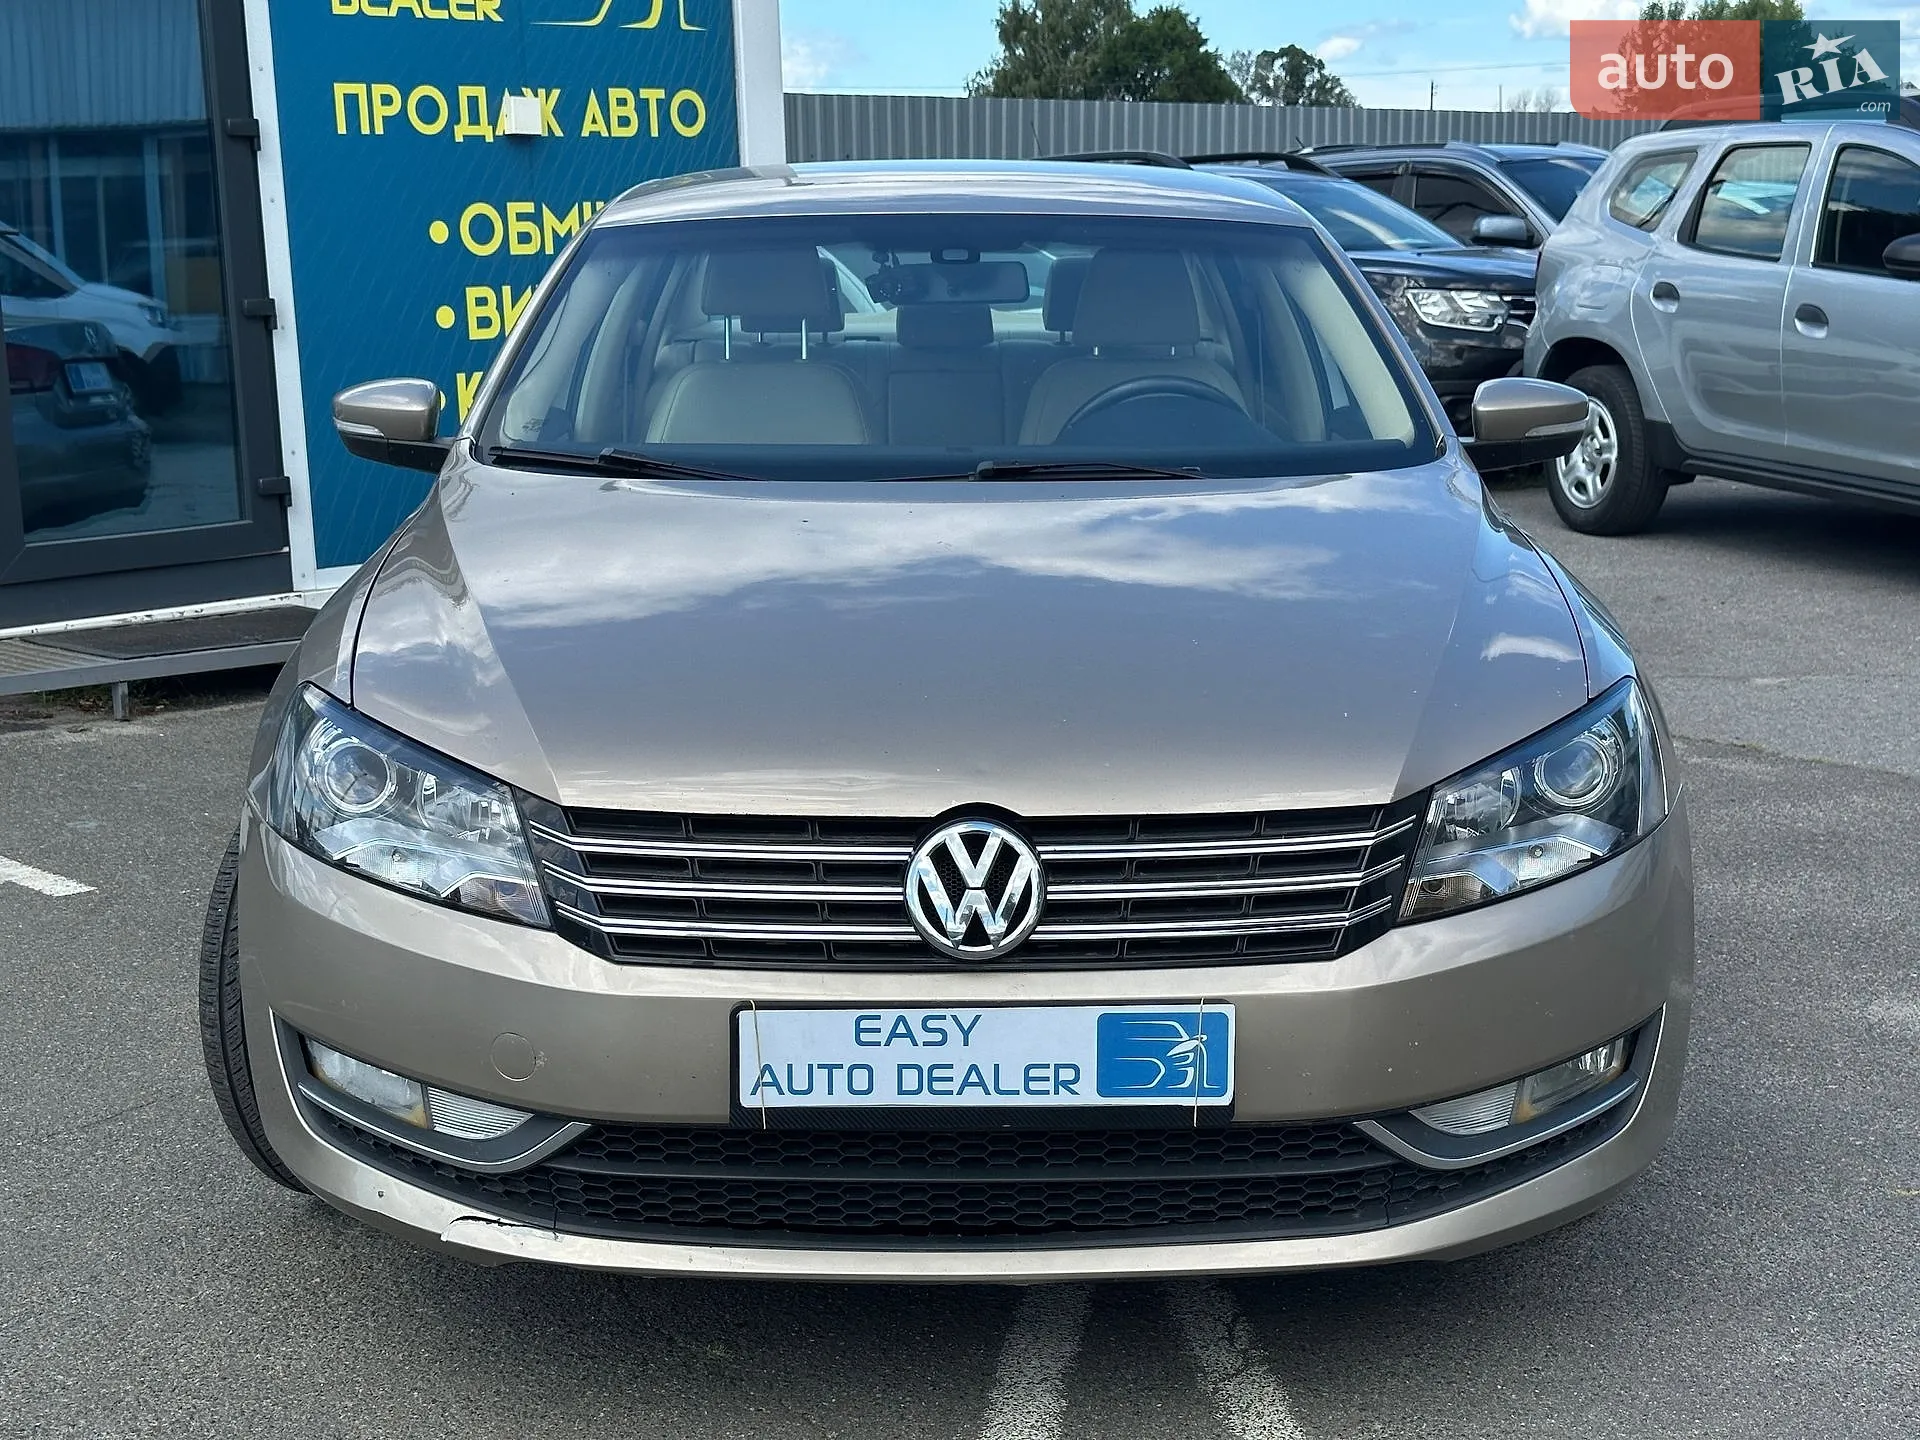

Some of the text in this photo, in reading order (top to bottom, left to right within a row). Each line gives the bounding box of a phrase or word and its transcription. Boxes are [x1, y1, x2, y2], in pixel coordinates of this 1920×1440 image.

[581, 87, 707, 138] АВТО
[854, 1014, 983, 1047] EASY
[749, 1063, 1081, 1096] AUTO DEALER
